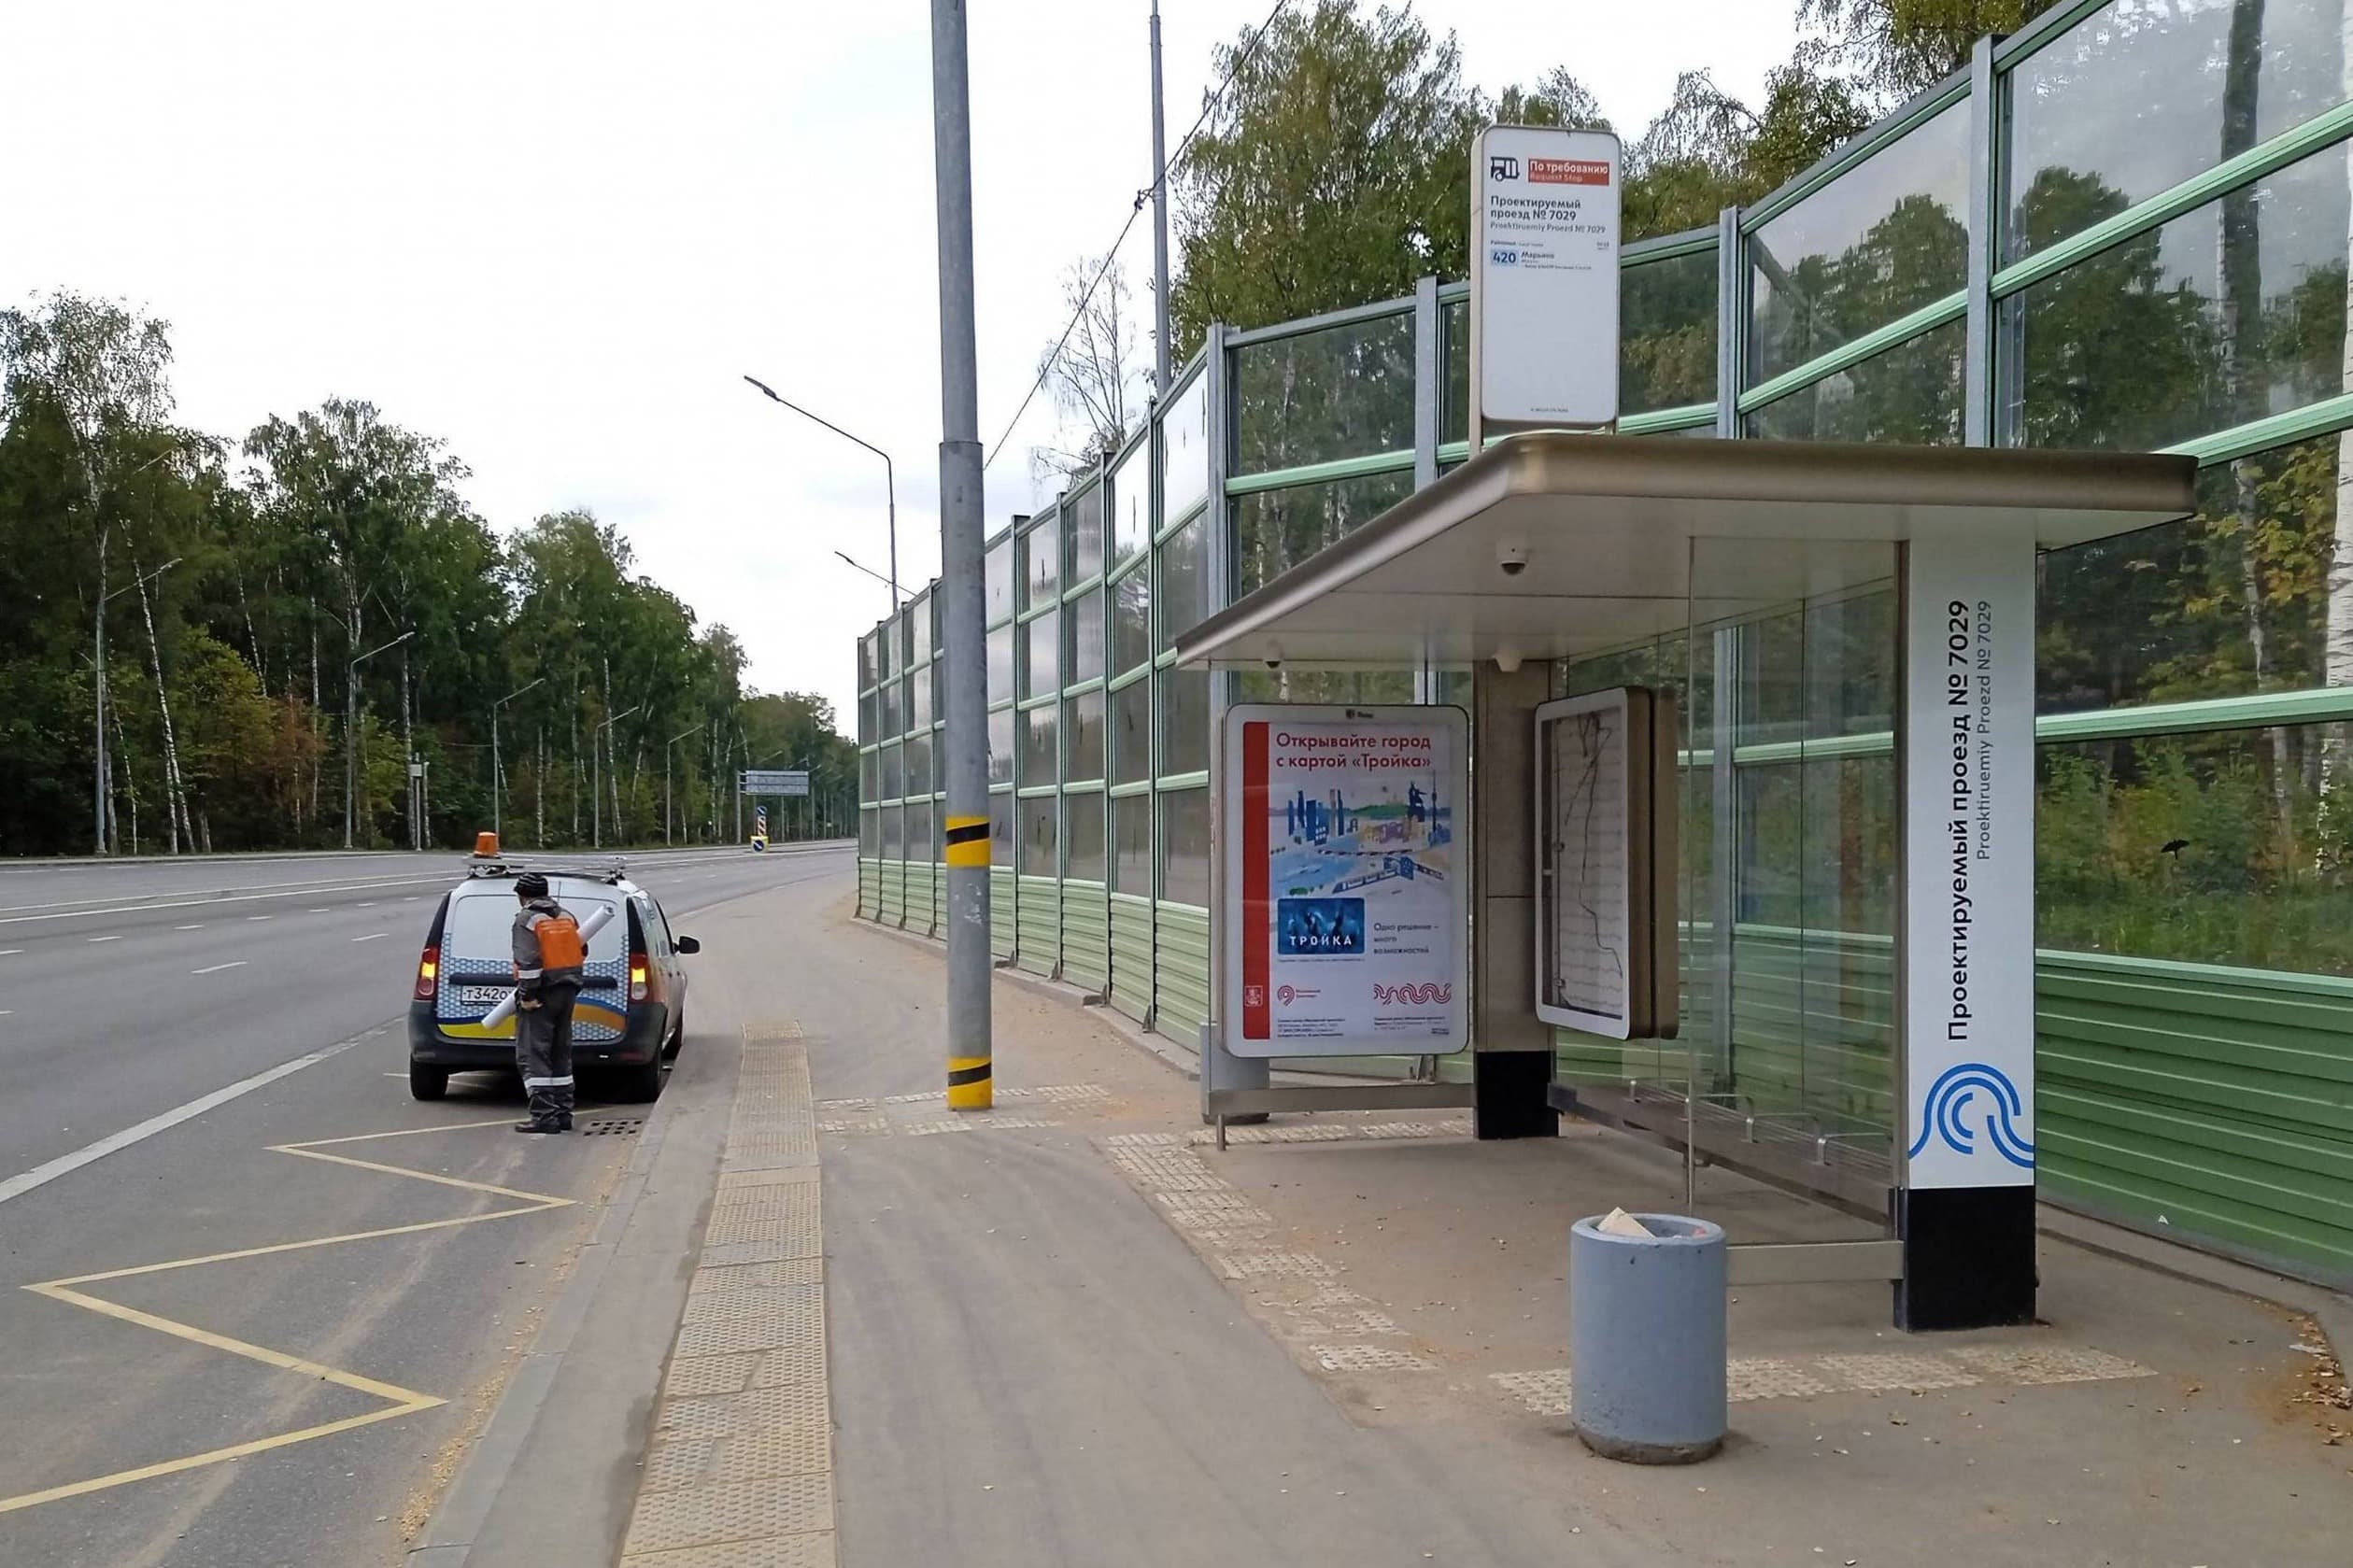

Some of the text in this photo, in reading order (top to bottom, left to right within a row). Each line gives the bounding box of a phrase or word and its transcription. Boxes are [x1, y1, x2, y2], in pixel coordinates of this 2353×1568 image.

[1530, 161, 1609, 174] По требованию
[1491, 195, 1581, 209] Проектируемый
[1491, 209, 1577, 220] проезд № 7029
[1587, 225, 1607, 233] 7029
[1493, 252, 1517, 263] 420
[1977, 600, 1994, 860] Proektiruemiy Proezd № 7029
[1276, 732, 1431, 751] Открывайте город
[1276, 754, 1431, 771] с картой «Тройка»
[1948, 600, 1972, 1040] Проектируемый проезд № 7029
[1289, 934, 1353, 946] ТРОЙКА
[466, 987, 513, 1000] Т342О
